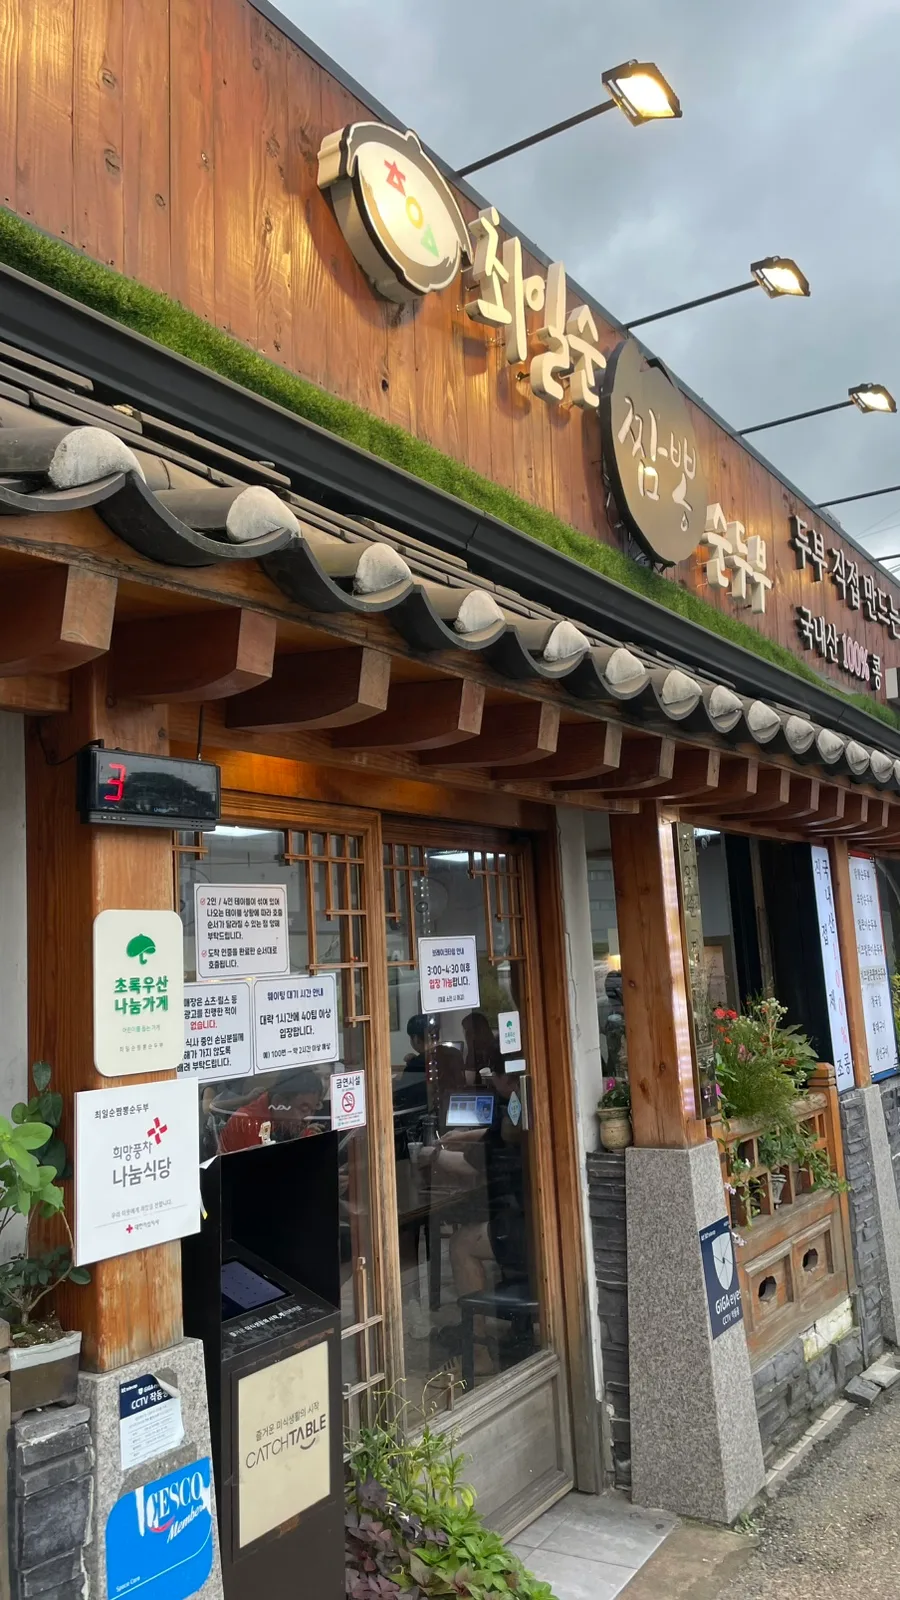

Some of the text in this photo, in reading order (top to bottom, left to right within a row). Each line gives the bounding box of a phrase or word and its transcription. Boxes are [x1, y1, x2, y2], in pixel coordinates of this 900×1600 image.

[466, 206, 607, 409] 최일순
[618, 396, 696, 532] 짬뽕
[700, 503, 772, 614] 순두부
[792, 515, 900, 640] 두부 직접 만드는
[799, 606, 883, 691] 국내산 100% 콩
[104, 763, 127, 801] 3
[207, 897, 216, 906] 2인
[223, 897, 232, 906] 4인
[207, 909, 224, 917] 나오는
[225, 909, 242, 917] 테이블
[243, 909, 259, 917] 상황에
[261, 909, 271, 917] 따라
[207, 920, 224, 929] 순서가
[251, 920, 261, 928] 있는
[208, 931, 243, 940] 부탁드립니다.
[208, 949, 219, 957] 도착
[221, 948, 237, 957] 인증을
[257, 946, 277, 955] 순서대로
[456, 947, 465, 955] 안내
[208, 960, 239, 969] 호출됩니다.
[459, 962, 471, 973] 이후
[114, 976, 169, 994] 초록우산
[429, 976, 470, 990] 입장 가능합니다.
[232, 995, 237, 1004] 등
[268, 988, 323, 1001] 웨이팅 대기 시간 안내
[114, 995, 169, 1016] 나눔가게
[184, 1007, 237, 1019] 광고를 진행한 적이
[260, 1008, 331, 1025] 대략 1시간에 40팀 이상
[190, 1020, 217, 1030] 없습니다.
[280, 1025, 315, 1039] 입장합니다.
[186, 1033, 244, 1047] 식사 중인 손님분들께
[184, 1046, 231, 1060] 해가 가지 않도록
[271, 1048, 286, 1058] 100번
[299, 1045, 311, 1053] 2시간
[312, 1044, 321, 1052] 이상
[193, 1058, 231, 1070] 부탁드립니다.
[336, 1076, 361, 1089] 금연시설
[94, 1103, 150, 1119] 최일순짬뽕순두부
[113, 1140, 153, 1161] 희망풍차
[113, 1157, 172, 1187] 나눔식당
[131, 1395, 150, 1410] CCTV
[255, 1400, 320, 1442] 즐거운 미식생활의 시작
[245, 1414, 328, 1470] CATCHTABLE
[146, 1472, 204, 1526] CESCO
